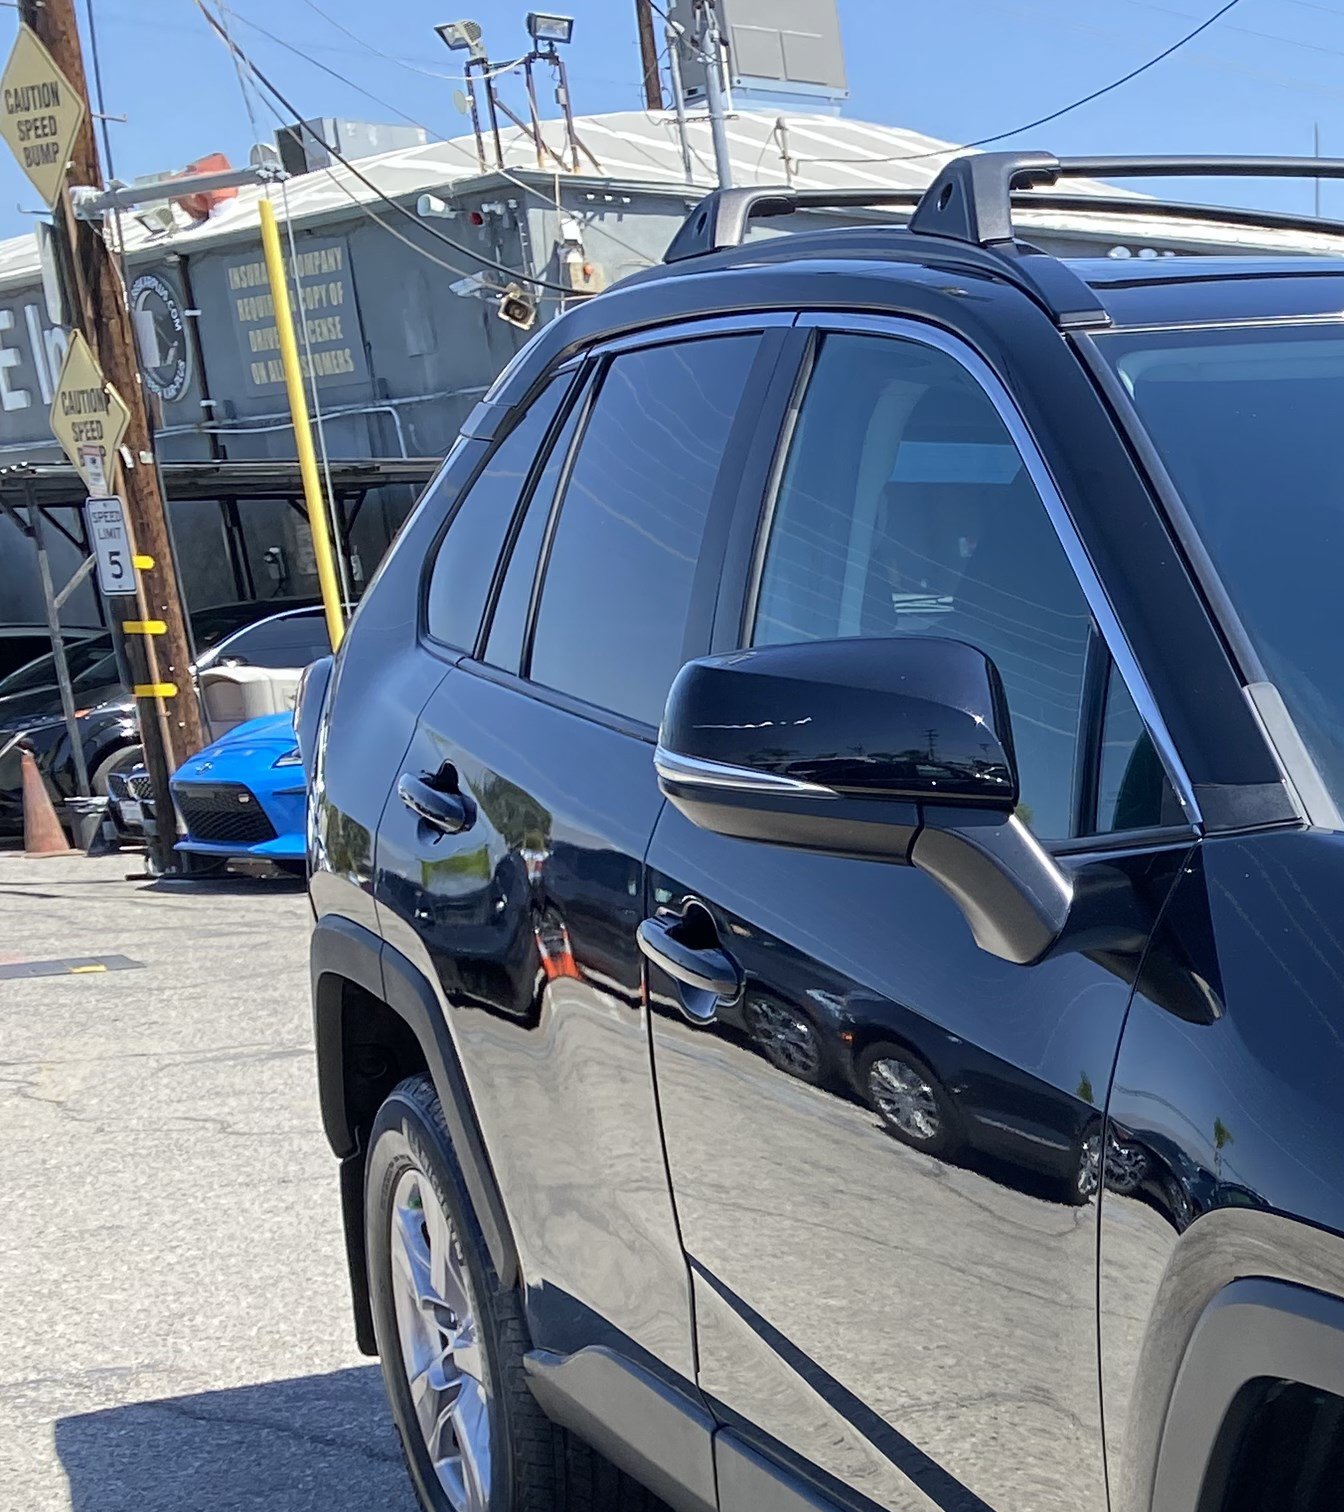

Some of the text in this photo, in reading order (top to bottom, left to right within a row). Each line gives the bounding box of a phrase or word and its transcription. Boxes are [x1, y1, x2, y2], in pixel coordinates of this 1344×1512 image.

[4, 81, 60, 115] CAUTION
[17, 115, 57, 141] SPEED
[23, 142, 59, 168] BUMP
[329, 281, 343, 306] OF
[298, 316, 344, 345] LCENSE
[300, 348, 355, 379] SOMERS
[61, 387, 108, 416] CAUTION
[72, 420, 103, 442] SPEED
[77, 445, 106, 467] BP
[92, 511, 121, 524] SPEED
[98, 527, 121, 540] LIMIT
[108, 551, 123, 579] 5
